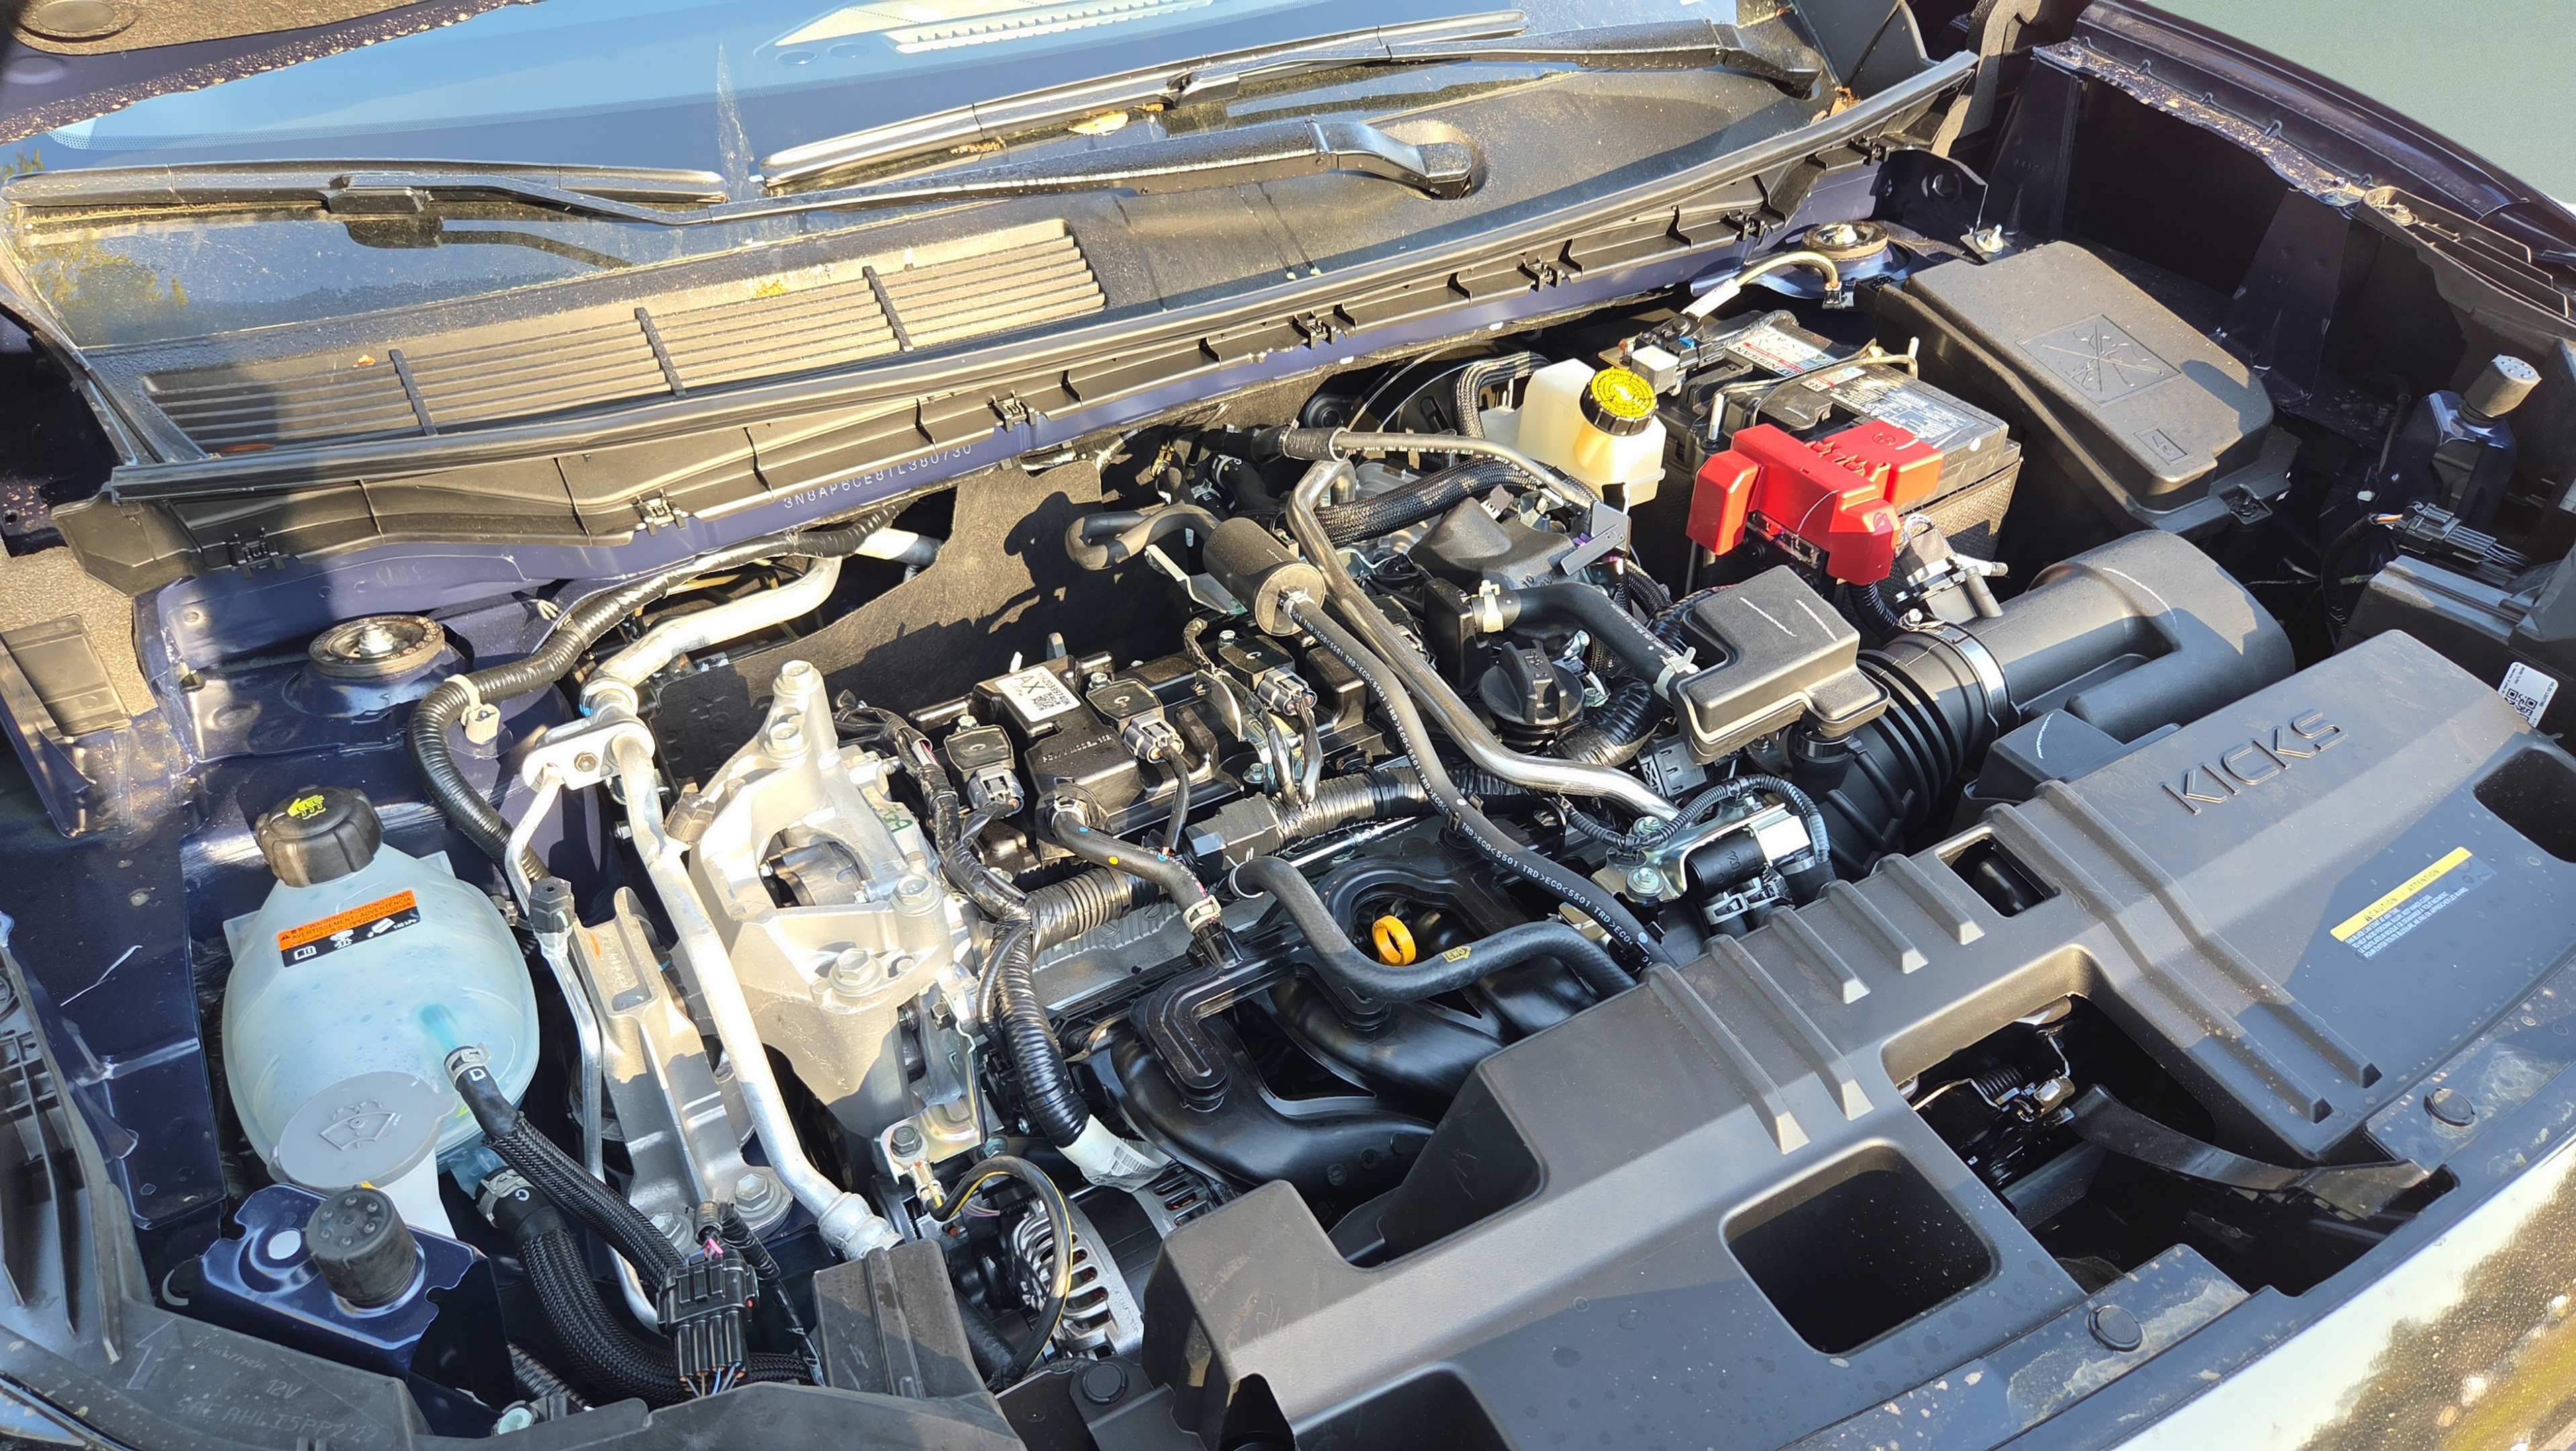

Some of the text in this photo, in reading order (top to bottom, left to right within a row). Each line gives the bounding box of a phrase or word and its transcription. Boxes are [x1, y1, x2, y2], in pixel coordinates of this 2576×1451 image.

[1014, 676, 1045, 694] AX
[2161, 709, 2348, 816] KICKS
[2368, 897, 2397, 916] CAUTION
[2407, 869, 2440, 892] ATTENTION
[308, 913, 344, 928] WARNING
[348, 899, 384, 916] ACHTUNG
[291, 915, 354, 940] AVERTISSEMENT
[469, 1069, 486, 1081] D
[265, 1378, 302, 1399] 12V
